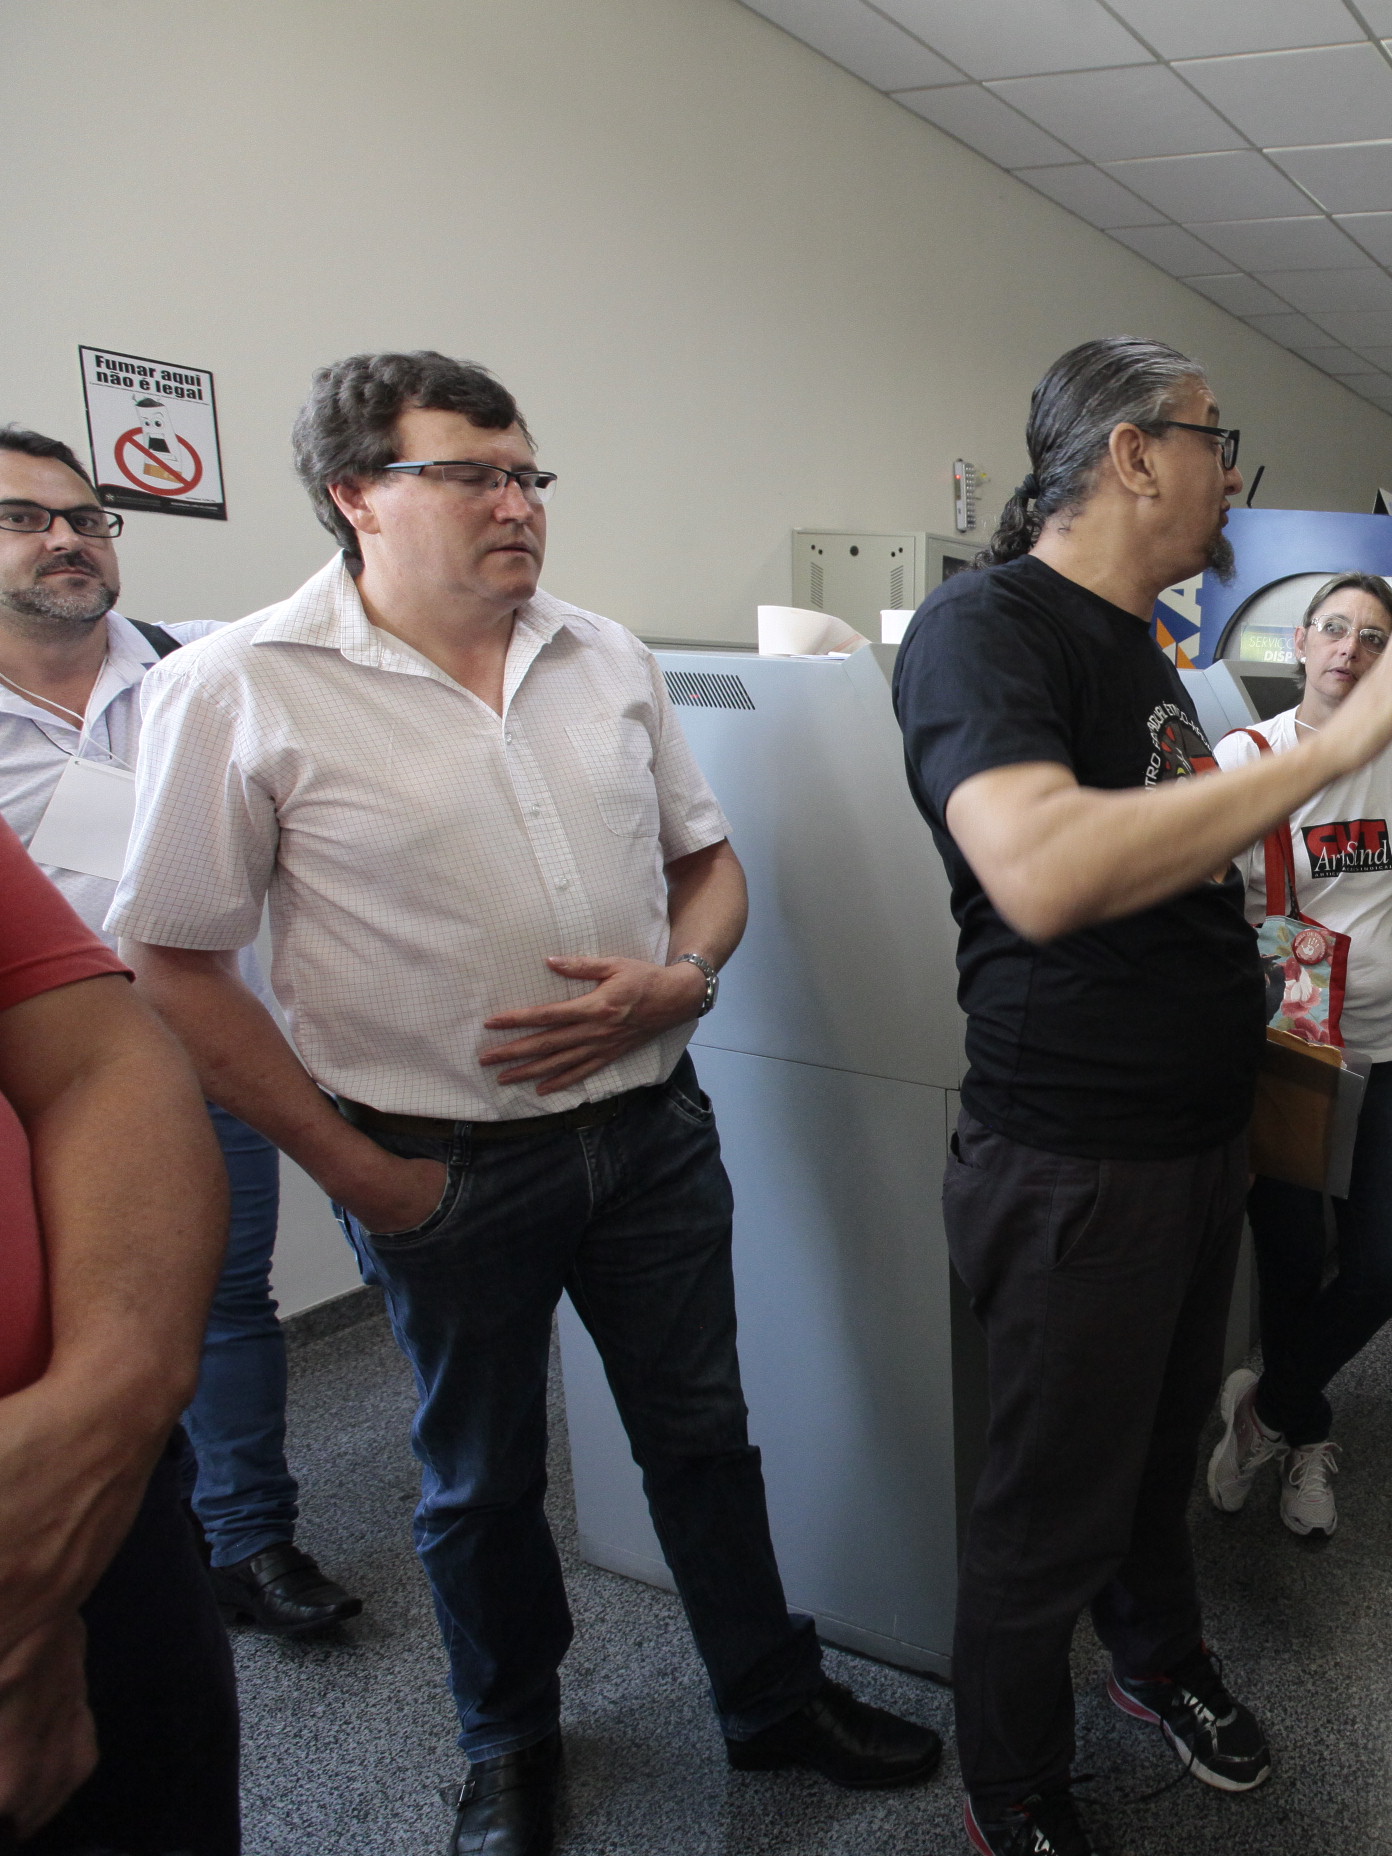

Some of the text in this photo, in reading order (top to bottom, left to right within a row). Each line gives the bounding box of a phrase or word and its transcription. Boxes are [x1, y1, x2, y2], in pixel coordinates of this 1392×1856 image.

[95, 354, 202, 388] Fumar aqui
[96, 370, 134, 388] não
[139, 377, 151, 391] é
[155, 380, 204, 401] legal
[1249, 636, 1295, 650] SERVIÇO
[1264, 650, 1294, 662] DISP
[1307, 820, 1386, 860] CUT
